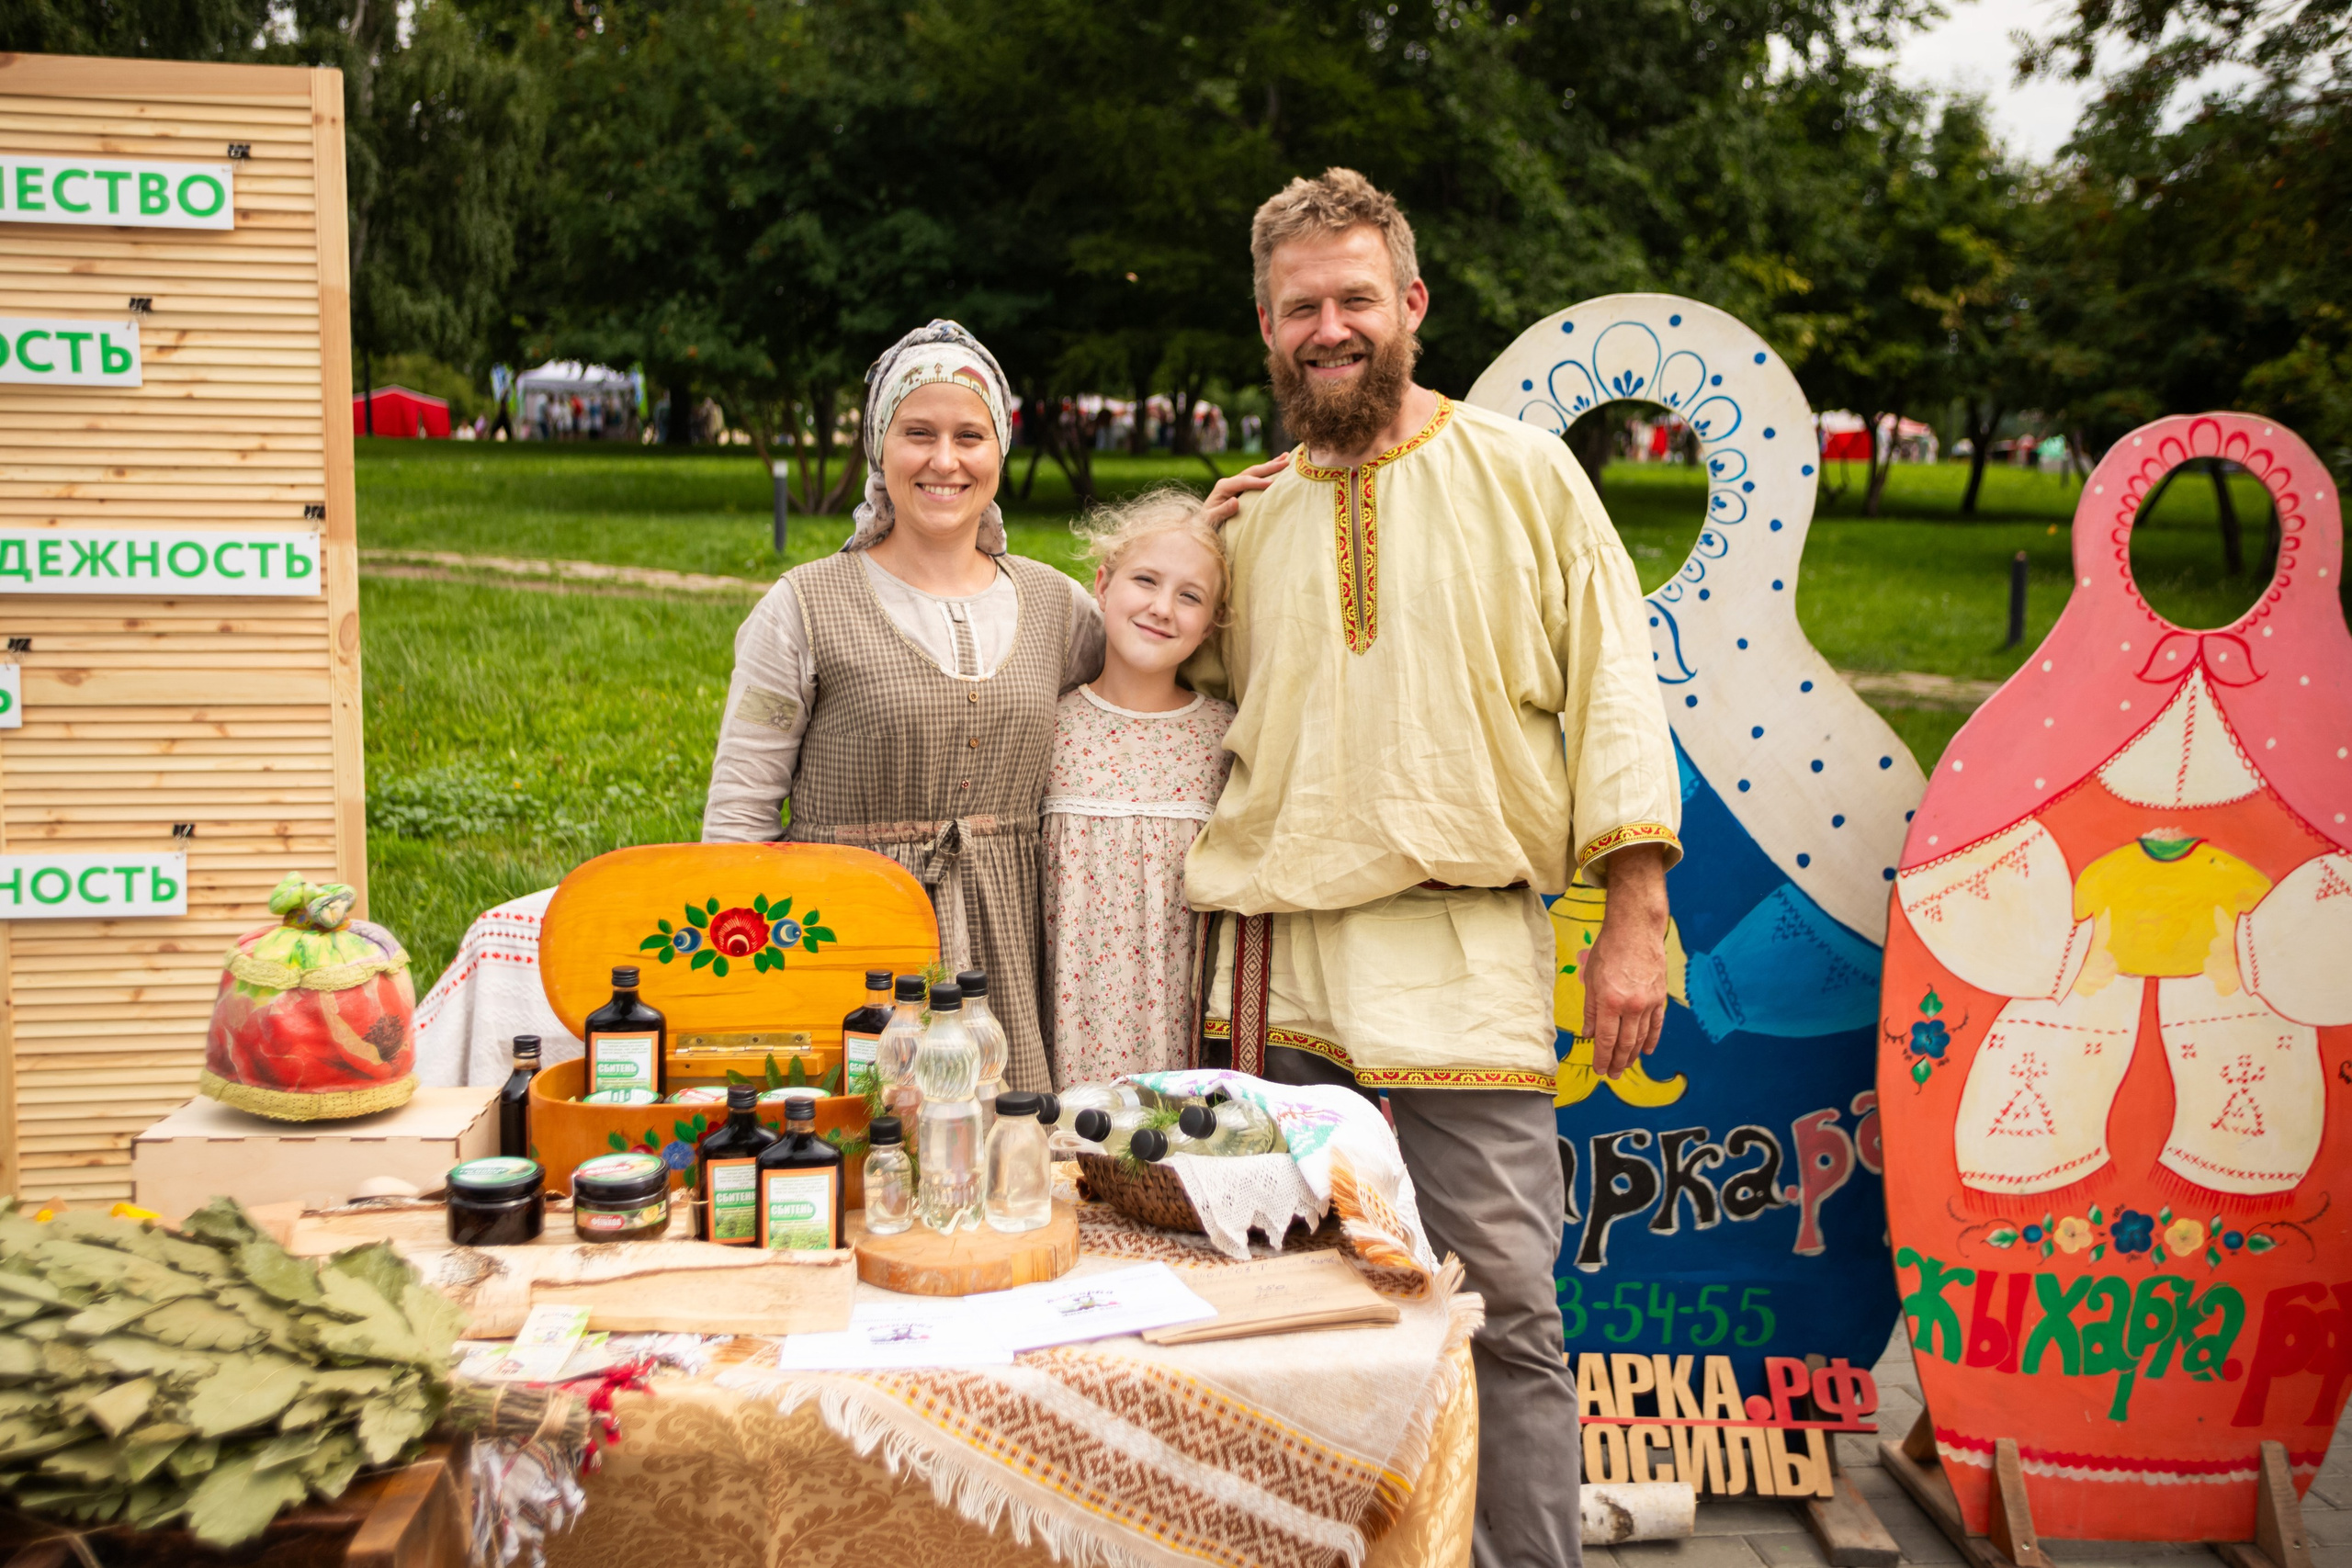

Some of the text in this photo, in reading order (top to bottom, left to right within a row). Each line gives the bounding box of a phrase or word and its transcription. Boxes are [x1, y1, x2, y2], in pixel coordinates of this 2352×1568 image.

[0, 165, 226, 219] ЕСТВО
[0, 329, 133, 375] СТЬ
[0, 539, 313, 583] ДЕЖНОСТЬ
[597, 1063, 637, 1073] СБИТЕНЬ
[771, 1203, 814, 1215] СБИТЕНЬ
[1563, 1351, 1880, 1426] АРКА.РФ
